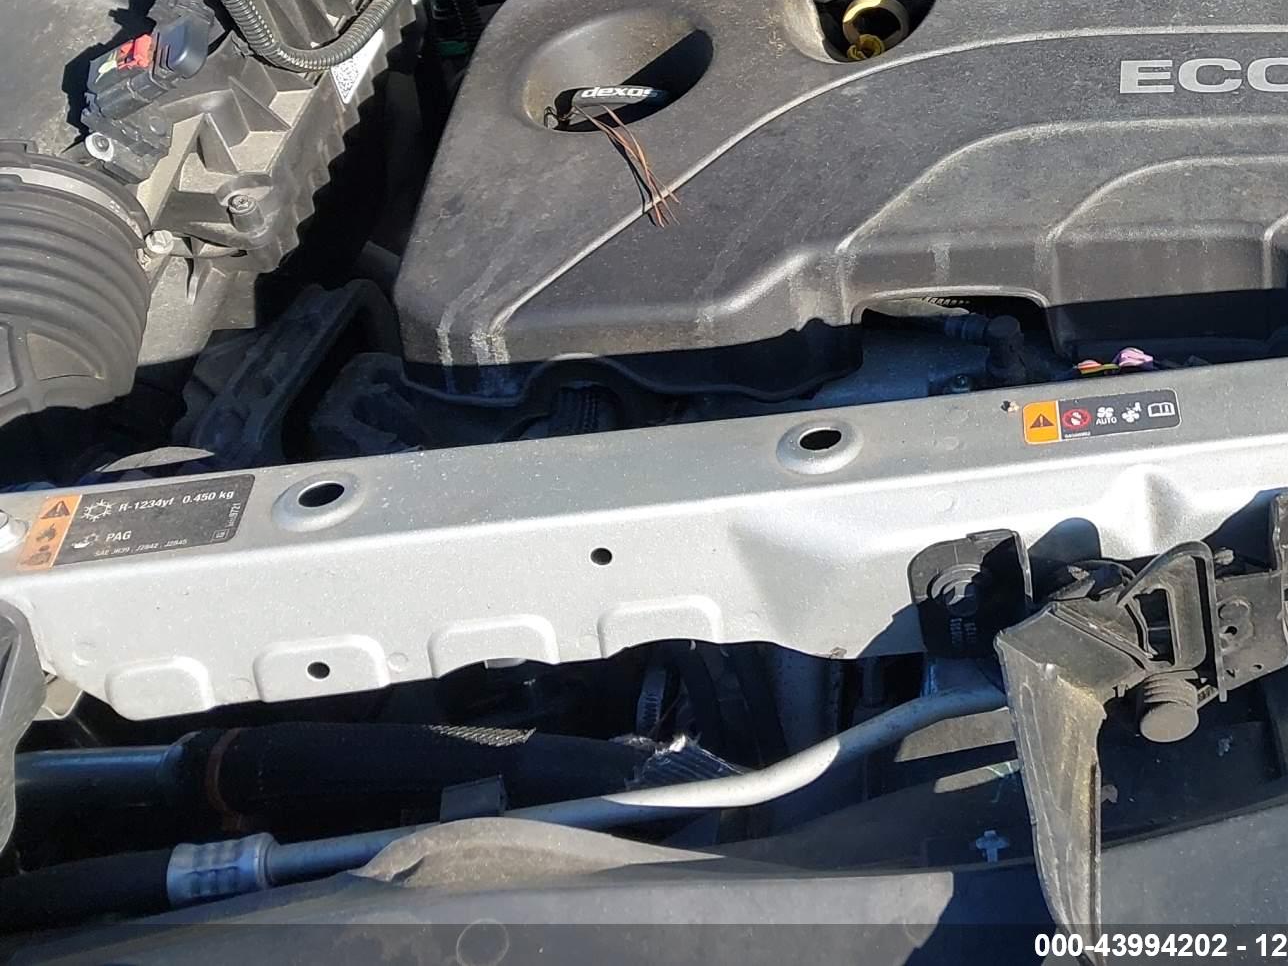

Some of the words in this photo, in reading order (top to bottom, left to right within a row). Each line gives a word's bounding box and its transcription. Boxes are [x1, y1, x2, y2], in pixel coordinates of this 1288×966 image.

[581, 86, 659, 99] dexos
[1095, 416, 1118, 426] AUTO
[119, 497, 175, 512] R-1234yf
[182, 492, 217, 505] 0.450
[218, 490, 235, 500] kg
[105, 530, 132, 542] PAG
